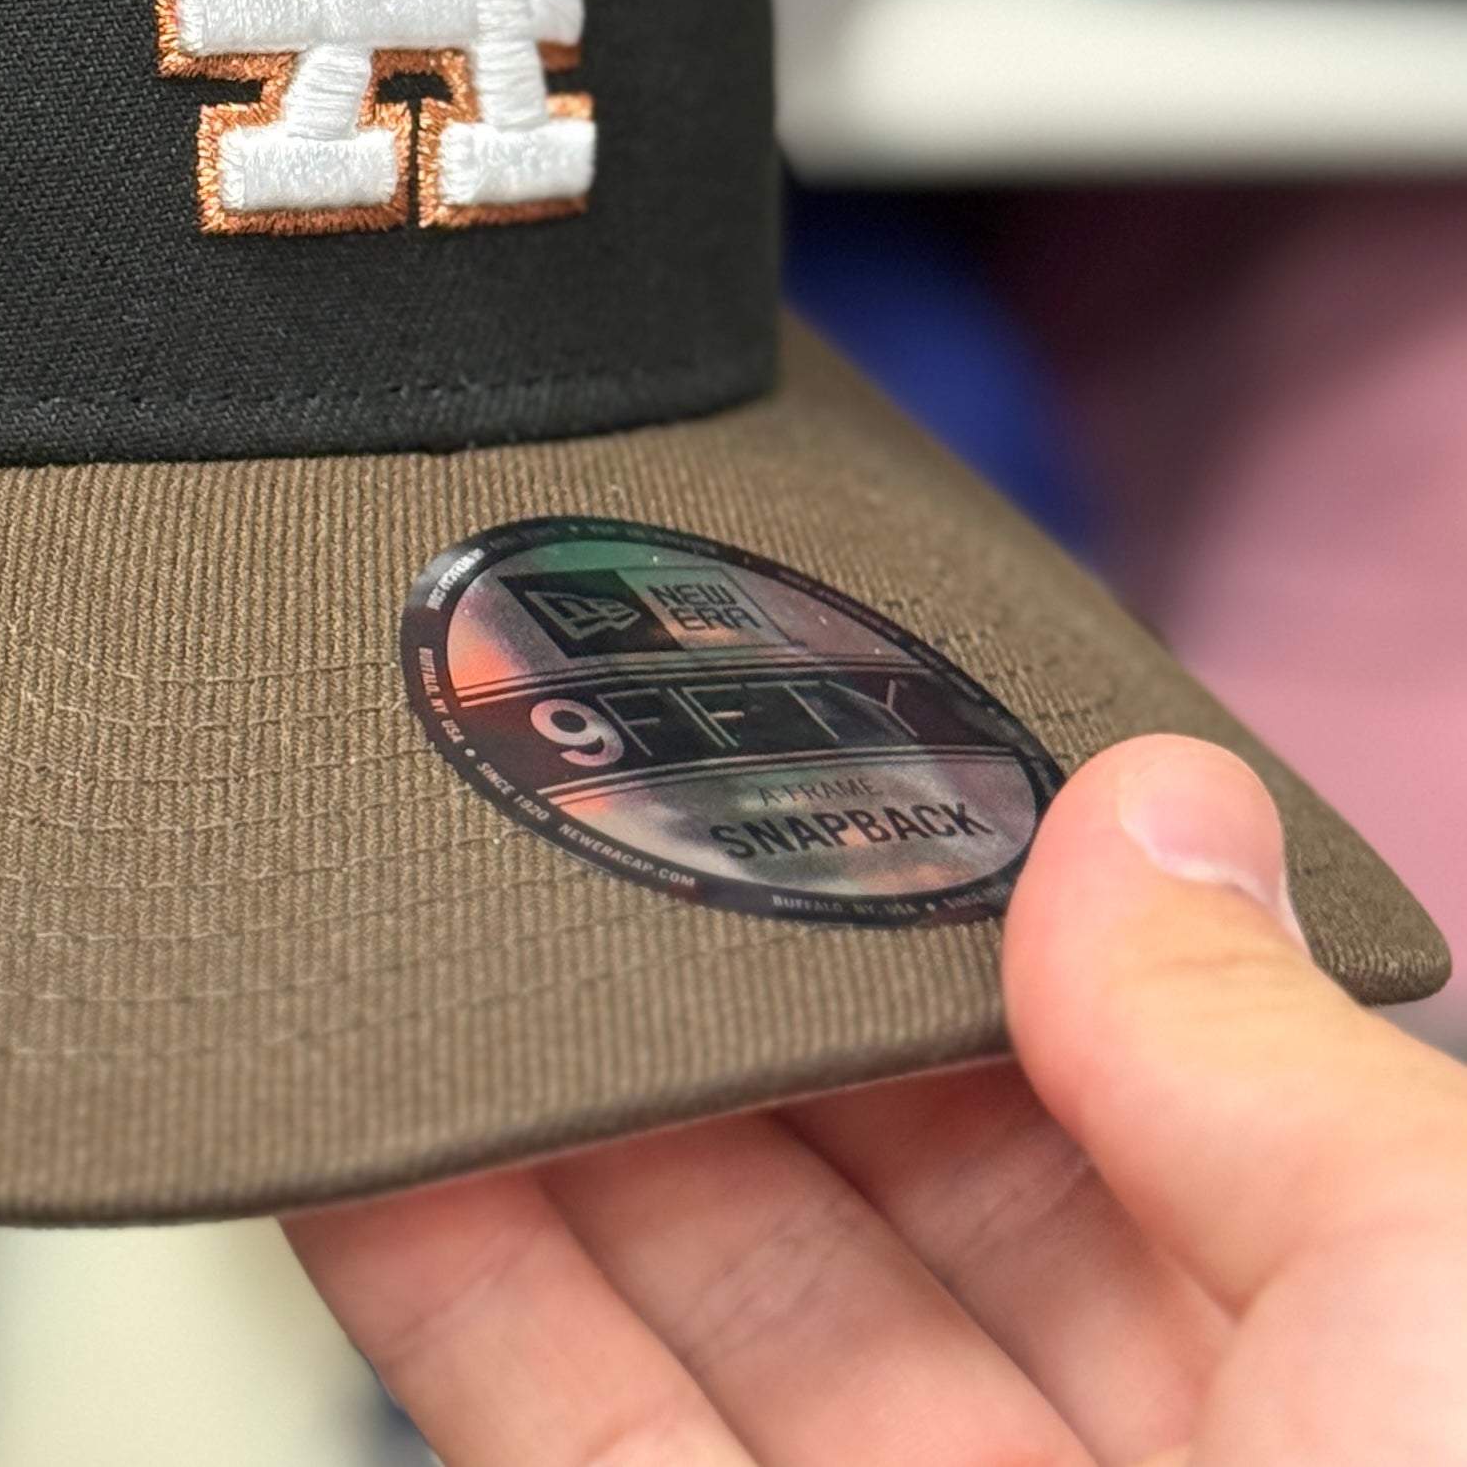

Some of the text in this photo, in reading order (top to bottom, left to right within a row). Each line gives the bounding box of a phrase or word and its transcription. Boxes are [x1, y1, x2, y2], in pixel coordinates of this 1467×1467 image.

[646, 583, 738, 607] NEW
[669, 605, 763, 632] ERA
[440, 719, 465, 744] USA
[476, 761, 516, 796] SINCE
[513, 794, 551, 821] 1920
[558, 823, 696, 887] NEWERACAP.COM
[758, 776, 885, 807] A-FRAME
[708, 801, 995, 860] SNAPBACK
